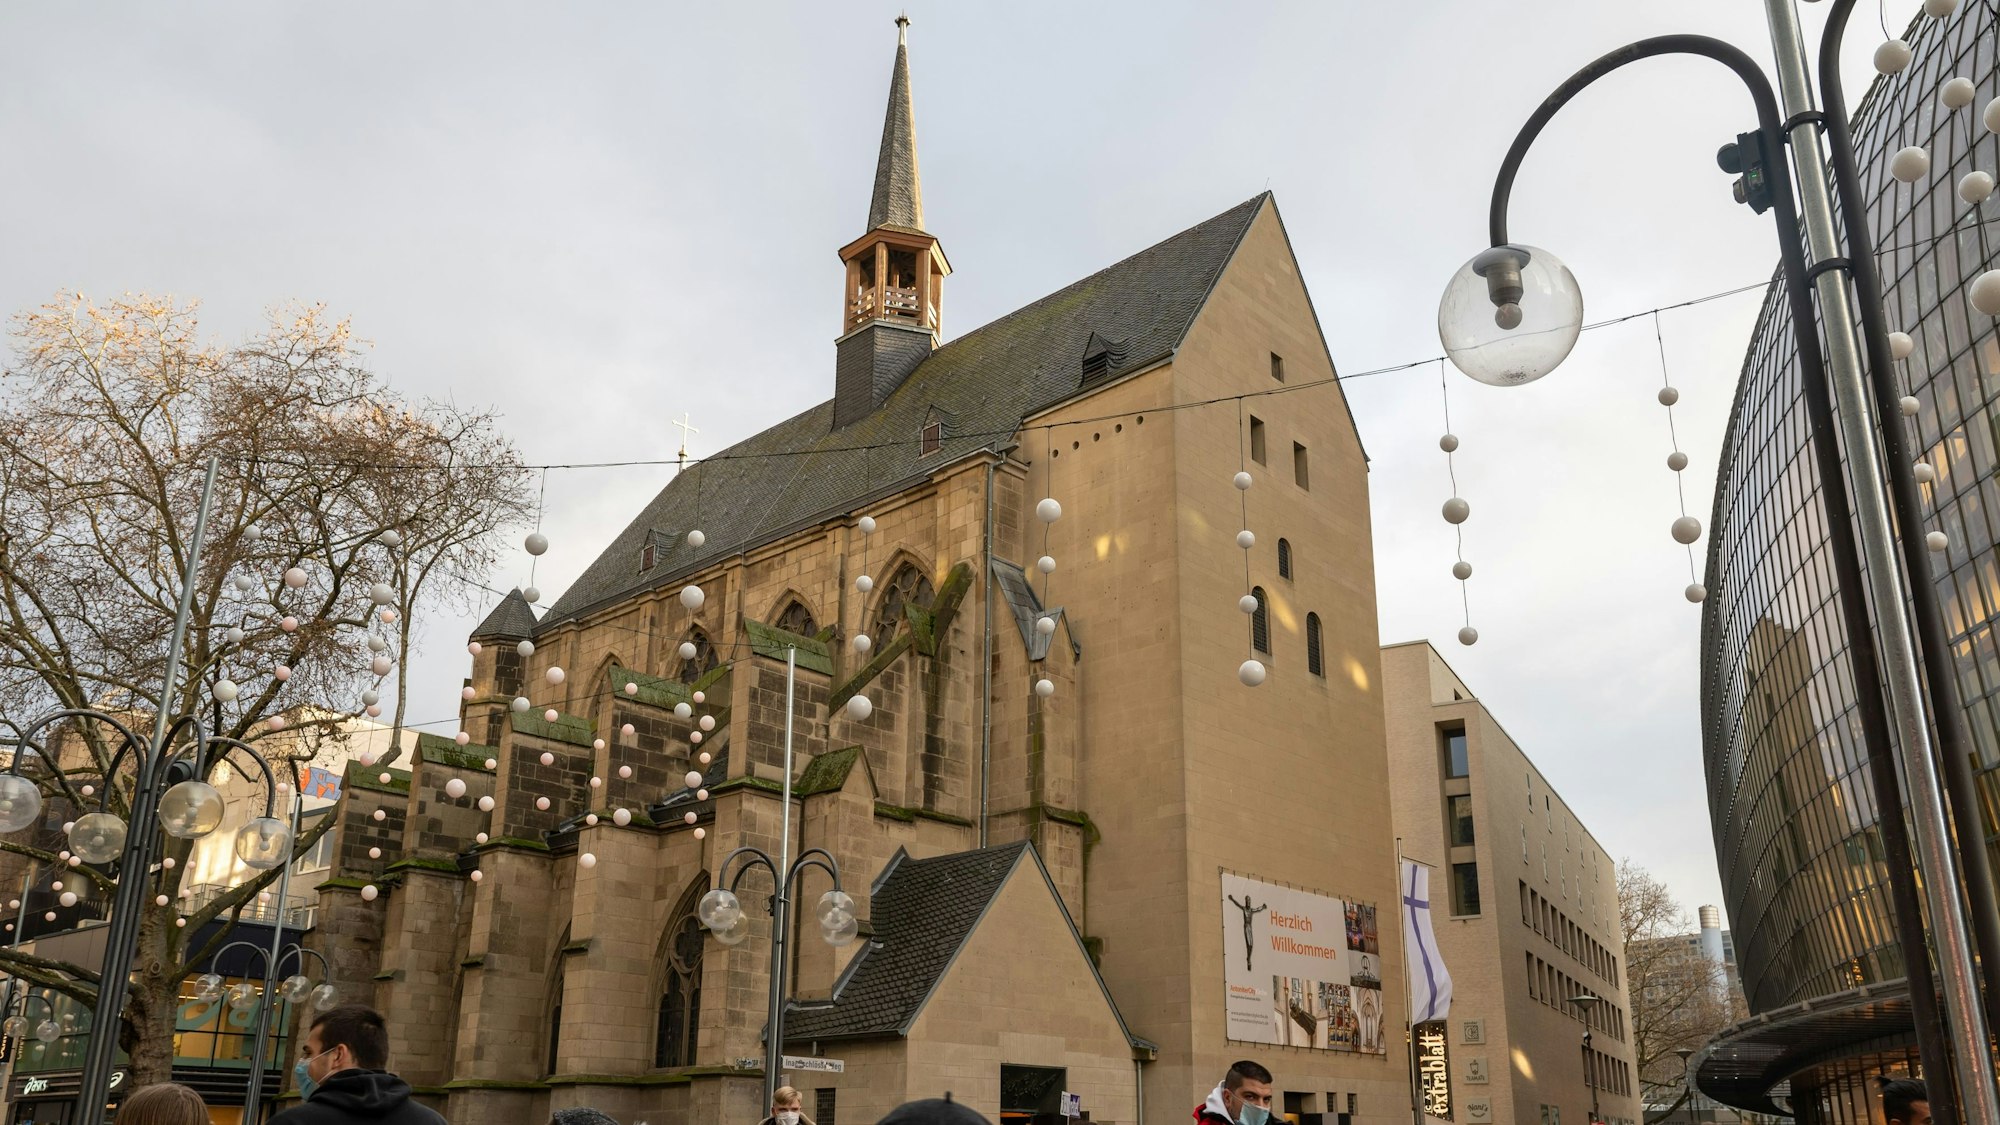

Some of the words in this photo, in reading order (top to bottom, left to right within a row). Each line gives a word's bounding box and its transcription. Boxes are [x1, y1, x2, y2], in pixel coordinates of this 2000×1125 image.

[1270, 910, 1313, 932] Herzlich
[1271, 935, 1336, 960] Willkommen
[1419, 1031, 1448, 1114] extrablatt
